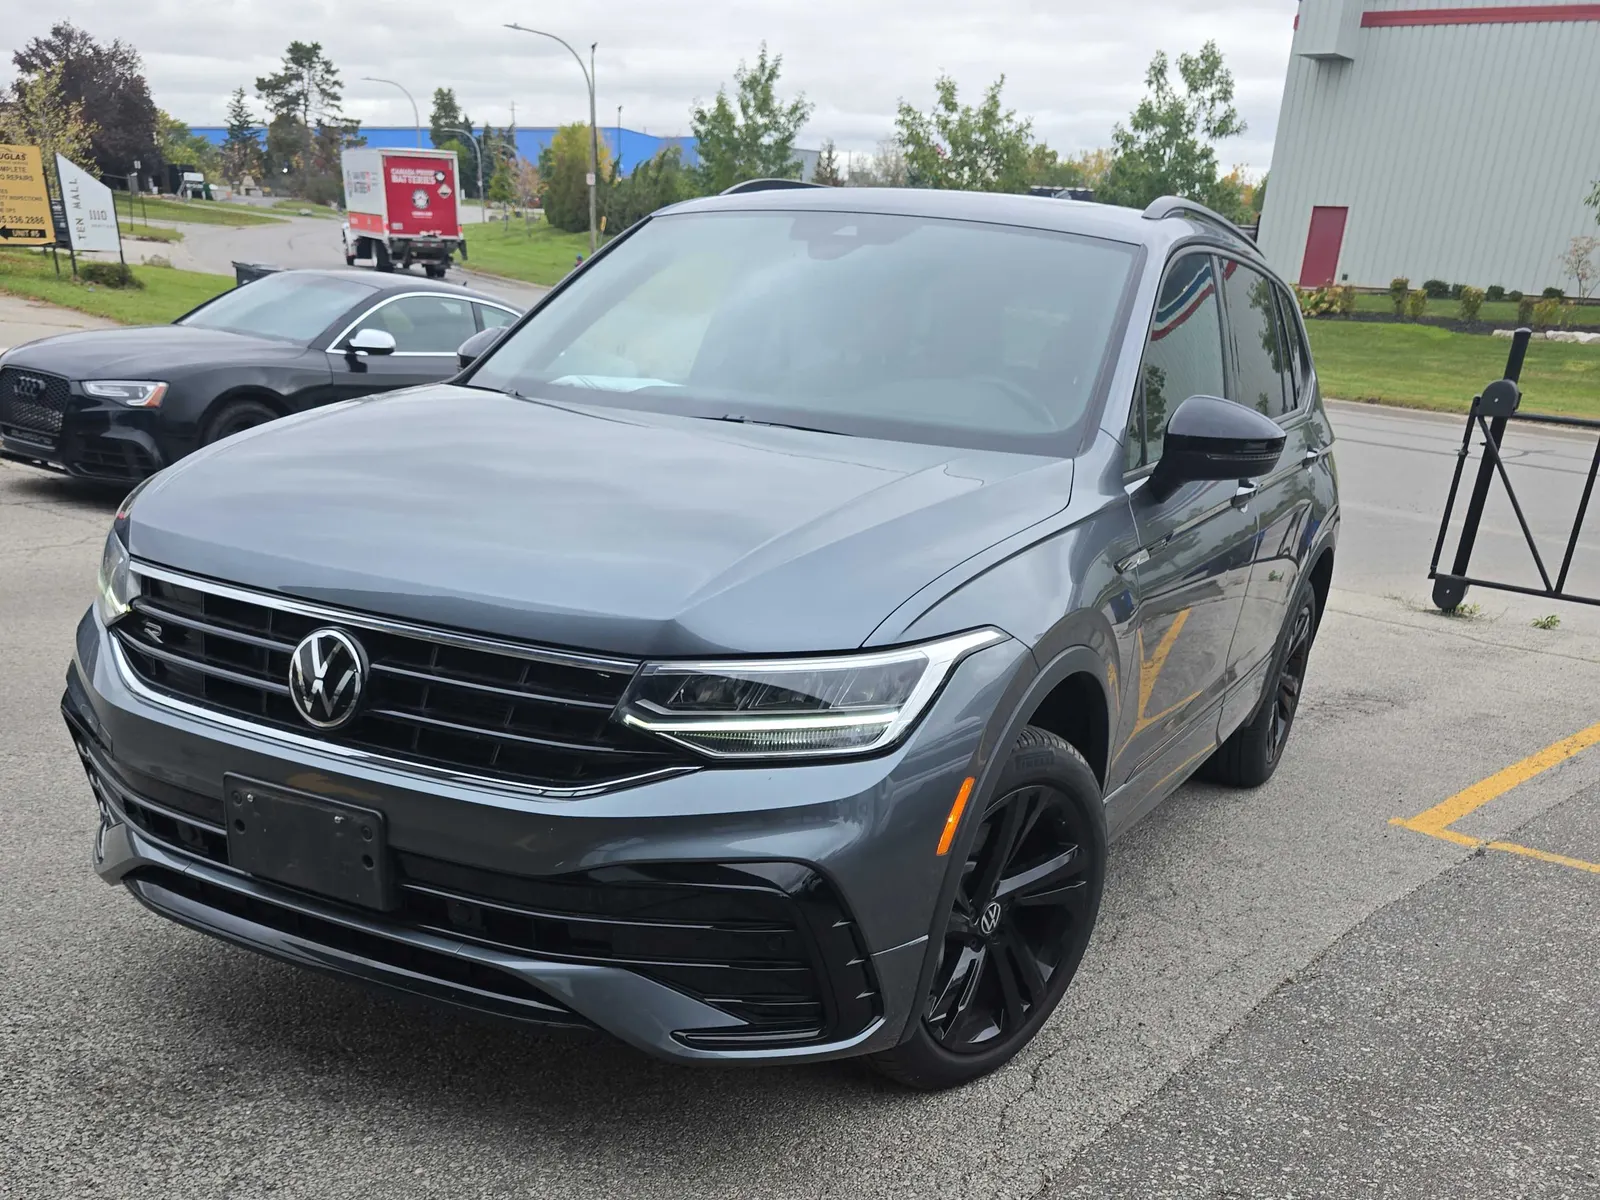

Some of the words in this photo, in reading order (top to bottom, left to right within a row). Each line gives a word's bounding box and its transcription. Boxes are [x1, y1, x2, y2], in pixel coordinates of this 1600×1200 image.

[391, 174, 436, 185] BATTERIES
[69, 178, 82, 210] MALL
[75, 217, 87, 241] TEN
